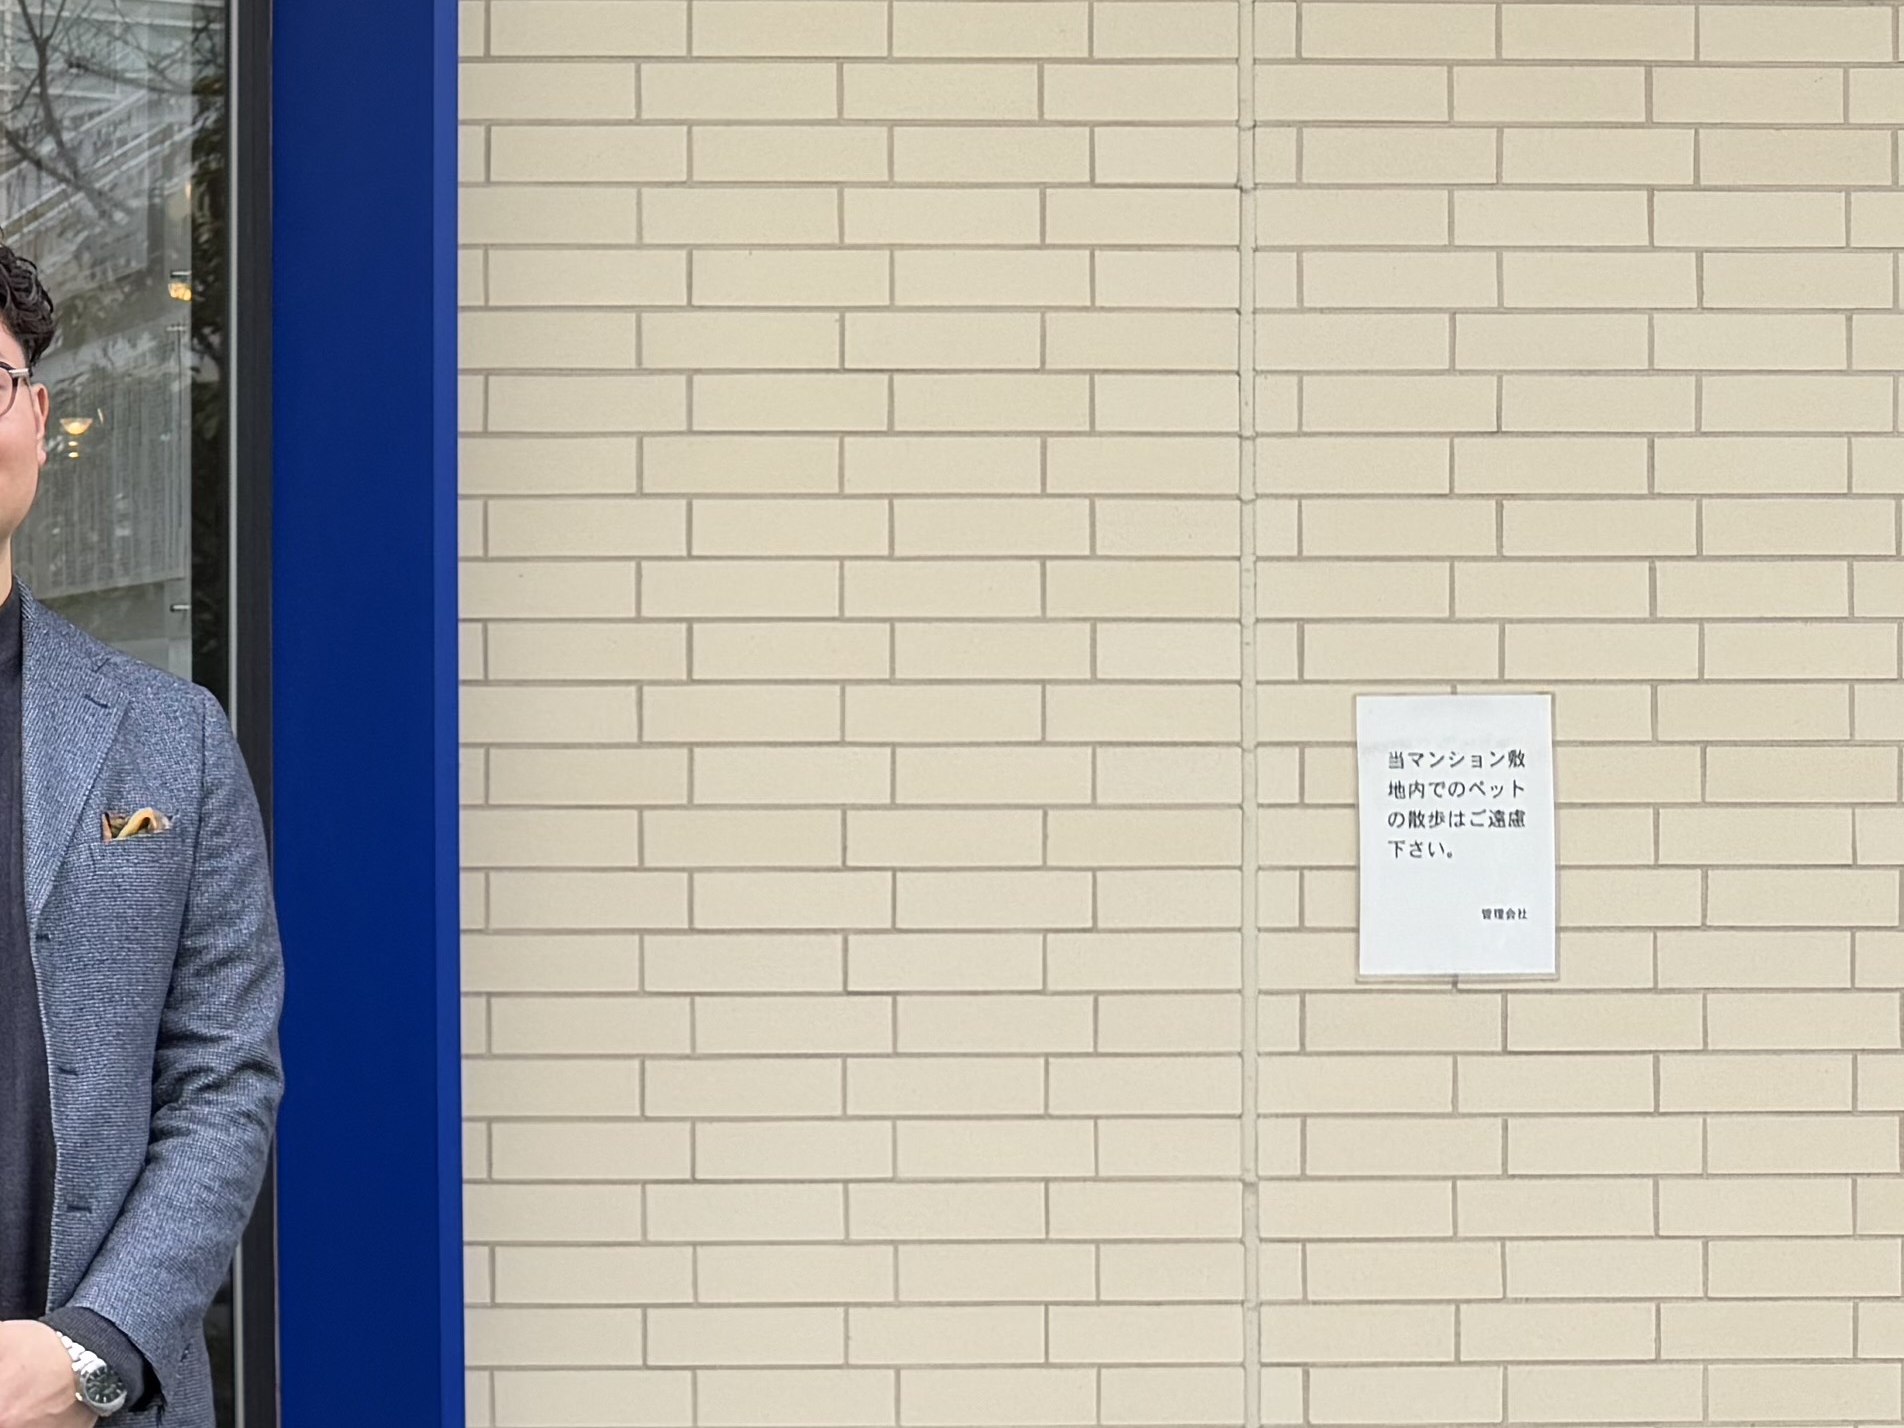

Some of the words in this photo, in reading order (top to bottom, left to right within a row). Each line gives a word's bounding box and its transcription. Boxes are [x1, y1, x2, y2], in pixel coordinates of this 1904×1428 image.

[1388, 749, 1526, 769] 当マンション敷
[1388, 779, 1525, 800] 地内でのペット
[1387, 809, 1526, 829] の散歩はご遠慮
[1387, 839, 1454, 859] 下さい。
